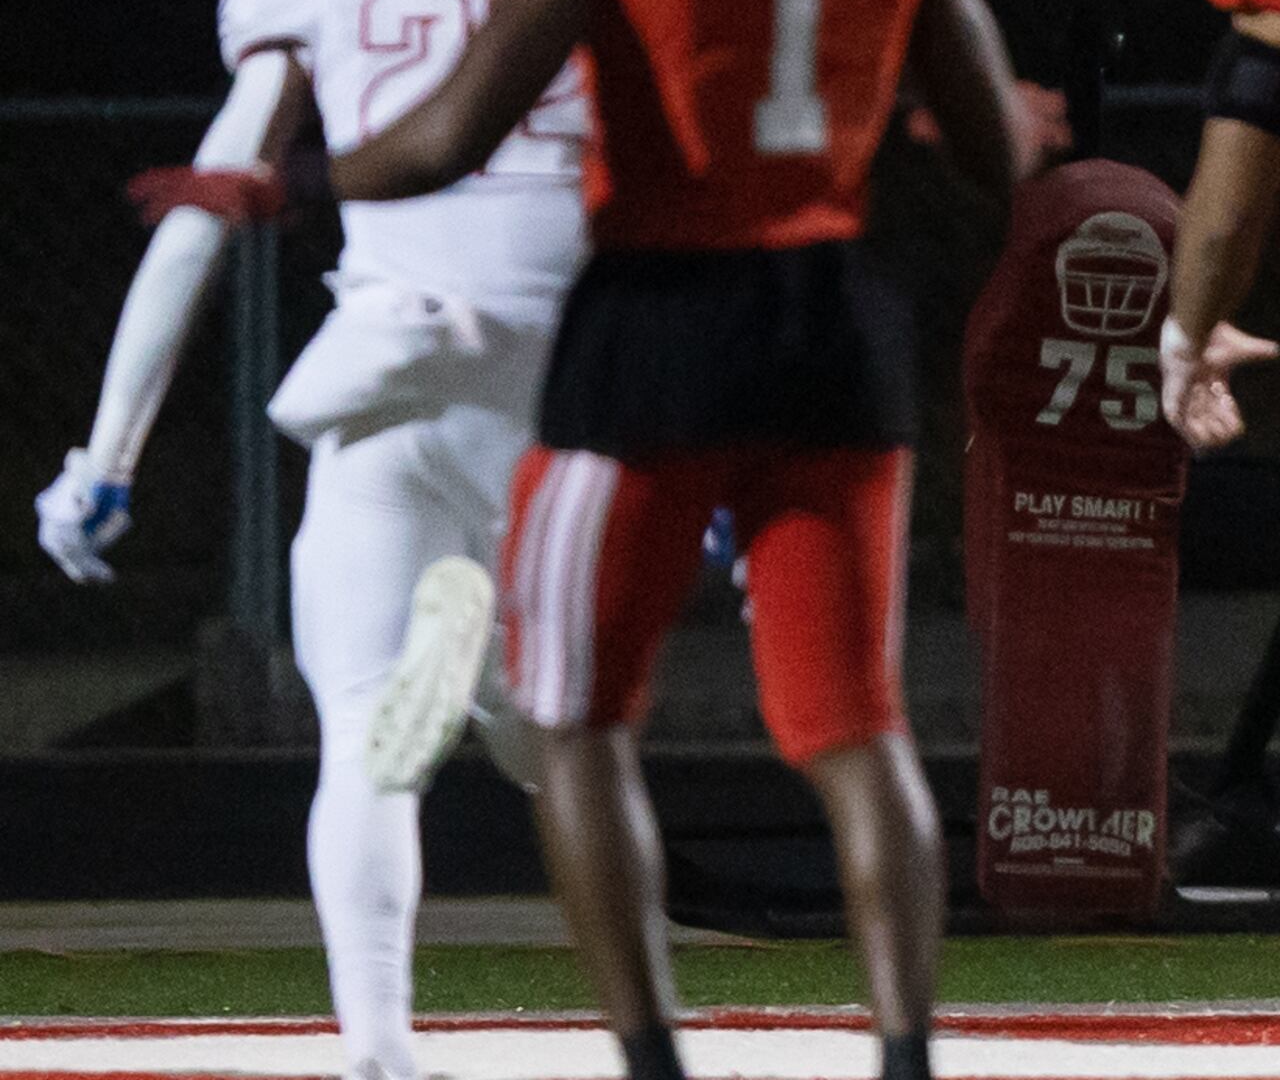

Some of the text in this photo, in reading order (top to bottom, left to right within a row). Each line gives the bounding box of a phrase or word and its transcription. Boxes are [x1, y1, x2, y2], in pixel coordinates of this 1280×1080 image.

[1036, 338, 1160, 431] 75
[1014, 491, 1066, 517] PLAY
[1071, 494, 1142, 522] SMART
[990, 785, 1049, 805] RAE
[988, 803, 1155, 848] CROWTHER
